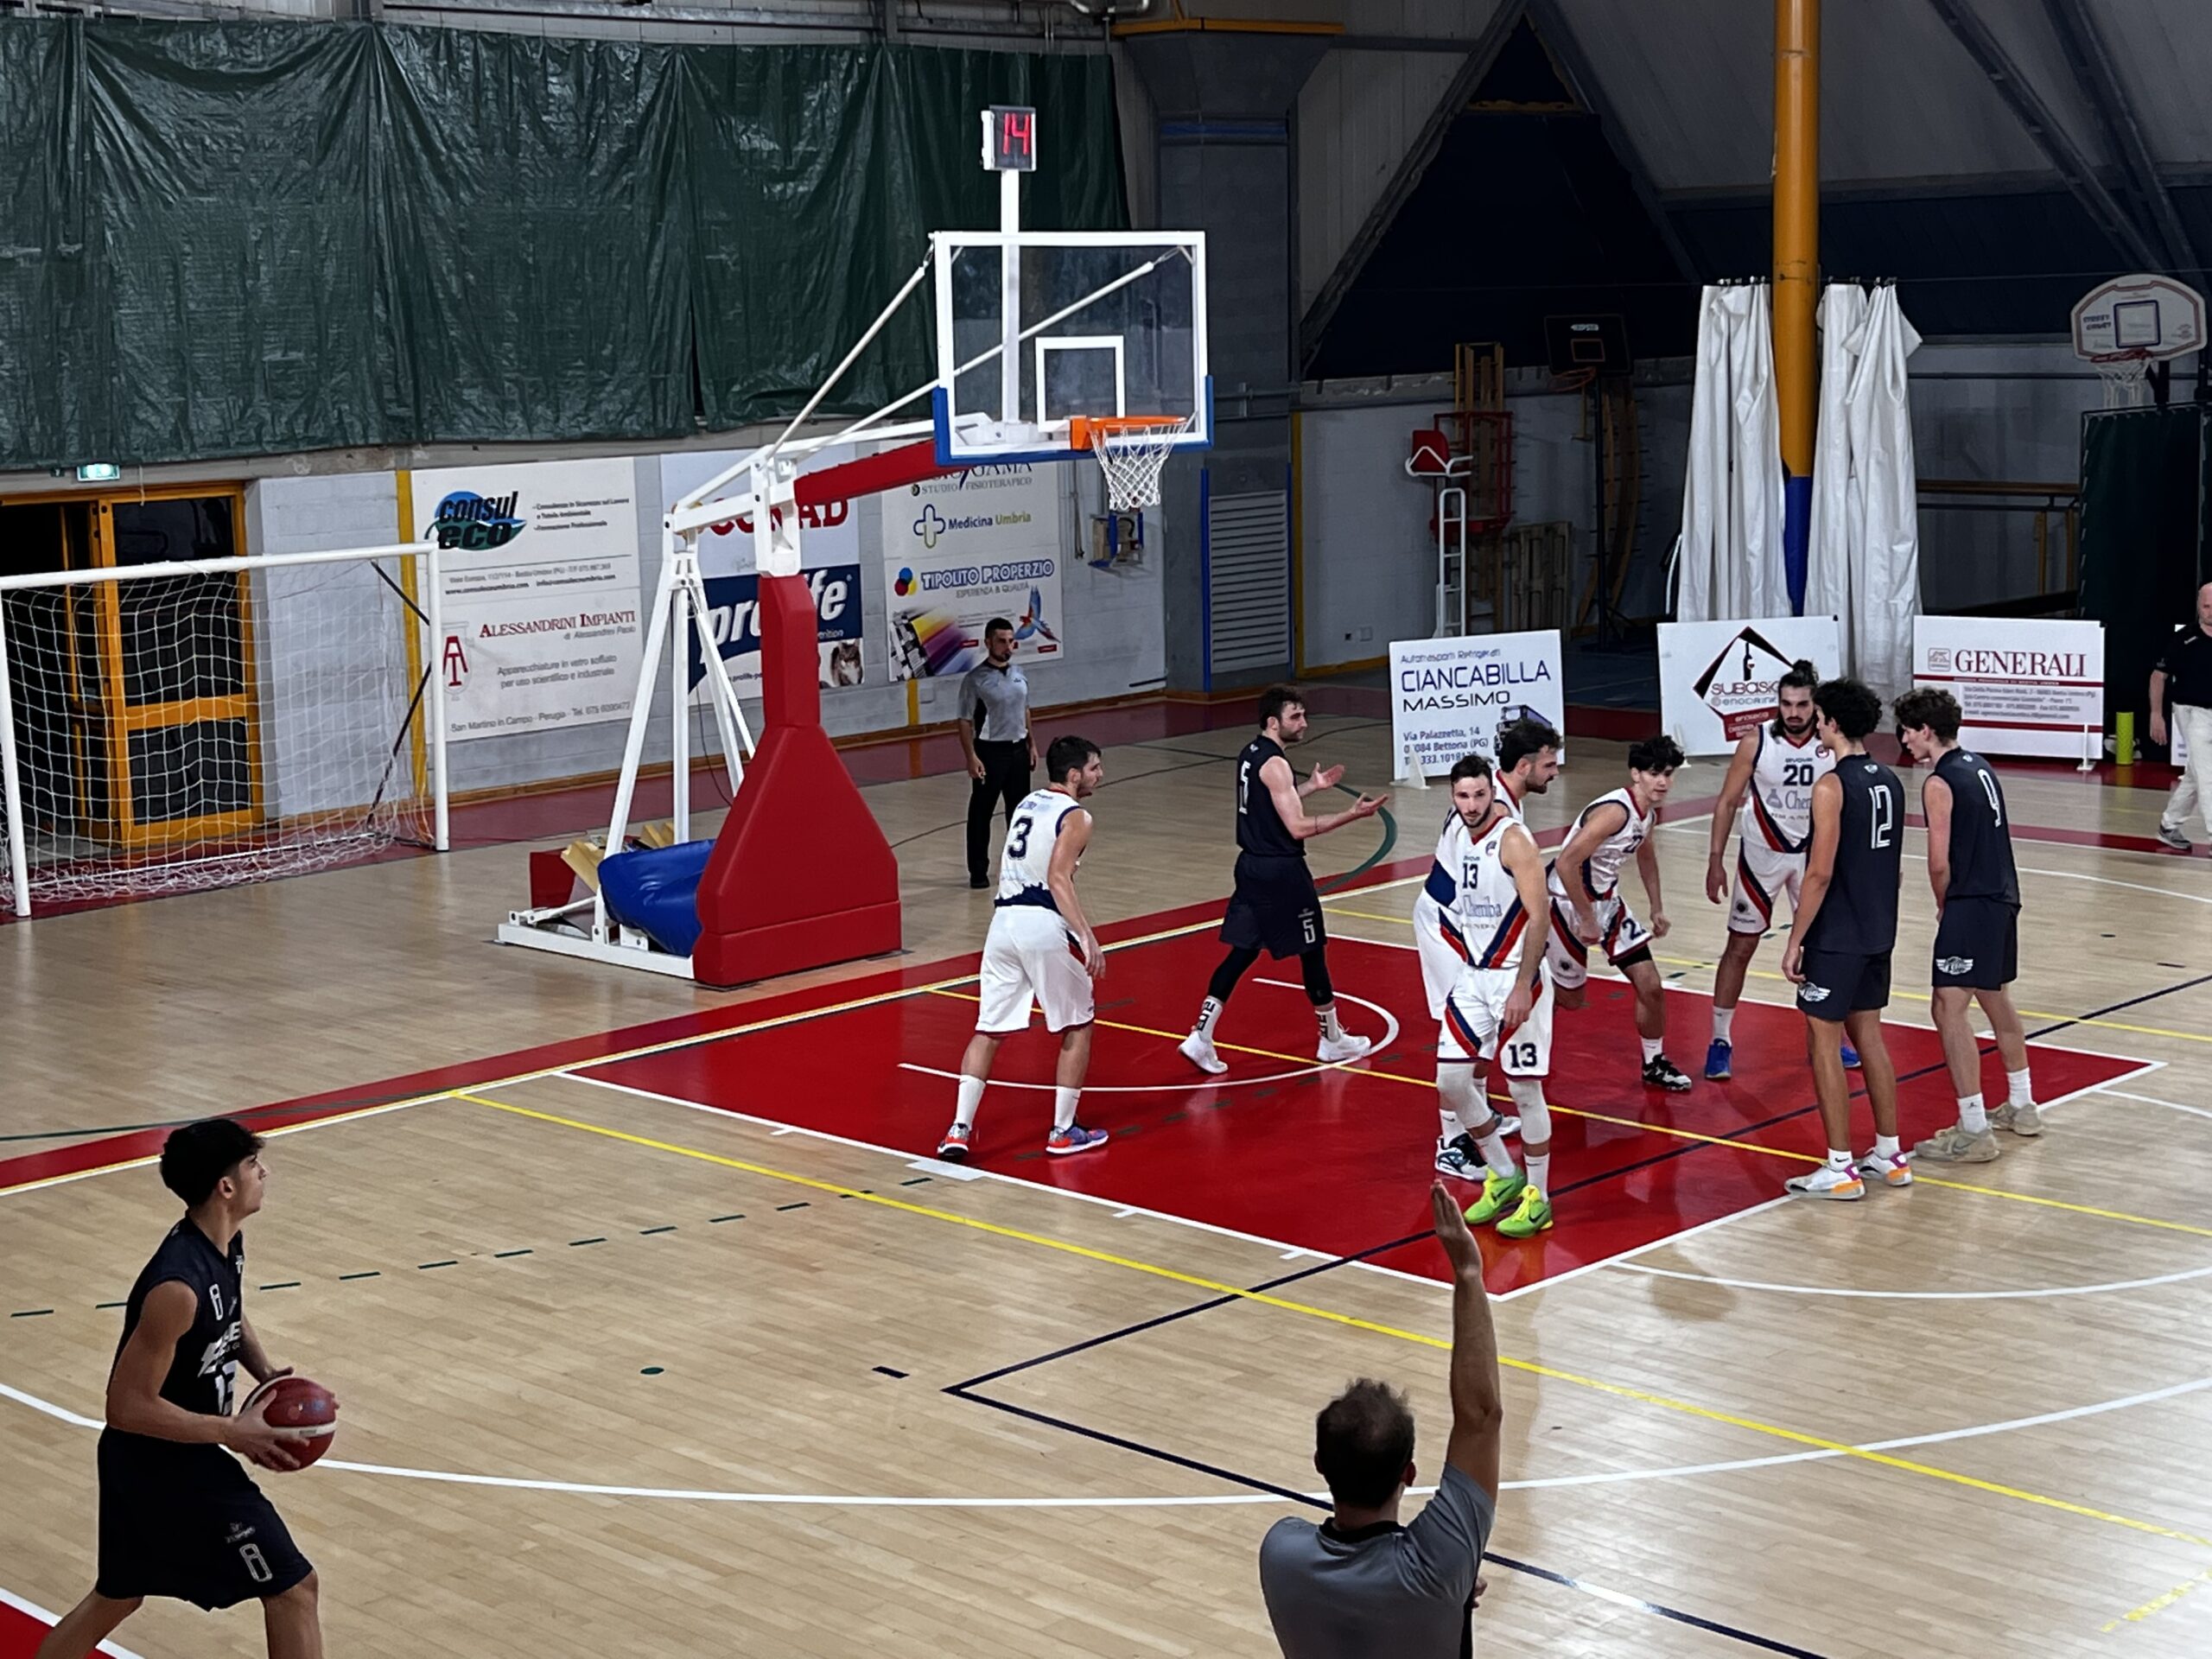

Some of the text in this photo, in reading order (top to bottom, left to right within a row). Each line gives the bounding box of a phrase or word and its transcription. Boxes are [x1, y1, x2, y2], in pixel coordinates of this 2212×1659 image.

[1003, 112, 1031, 156] 14
[921, 477, 1033, 495] STUDIO FISIOTERAPICO
[439, 491, 518, 524] consul
[948, 512, 1032, 530] Medicina Umbria
[437, 522, 512, 550] eco
[921, 559, 1054, 590] TIPOLITO PROPERZIO
[956, 587, 993, 599] ESPERIENZA
[480, 610, 636, 638] ALESSANDRINI IMPIANTI
[1402, 660, 1551, 692] CIANCABILLA
[1955, 649, 2087, 677] GENERALI
[500, 679, 514, 690] per
[516, 678, 530, 687] uso
[532, 672, 569, 685] scientifico
[1402, 690, 1510, 713] MASSIMO
[450, 723, 467, 733] San
[468, 718, 497, 730] Martino
[505, 715, 533, 727] Campo
[538, 712, 566, 722] Perugia
[1403, 732, 1417, 741] Via
[1469, 727, 1480, 735] 14
[1404, 738, 1489, 753] 0084 Bettona (PG)
[1783, 765, 1815, 786] 20
[1977, 769, 2001, 828] 9
[1868, 785, 1892, 849] 12
[1007, 816, 1033, 861] 3
[1463, 862, 1478, 889] 13
[1302, 918, 1316, 944] 5
[1622, 918, 1647, 940] 2
[1508, 1042, 1537, 1069] 13
